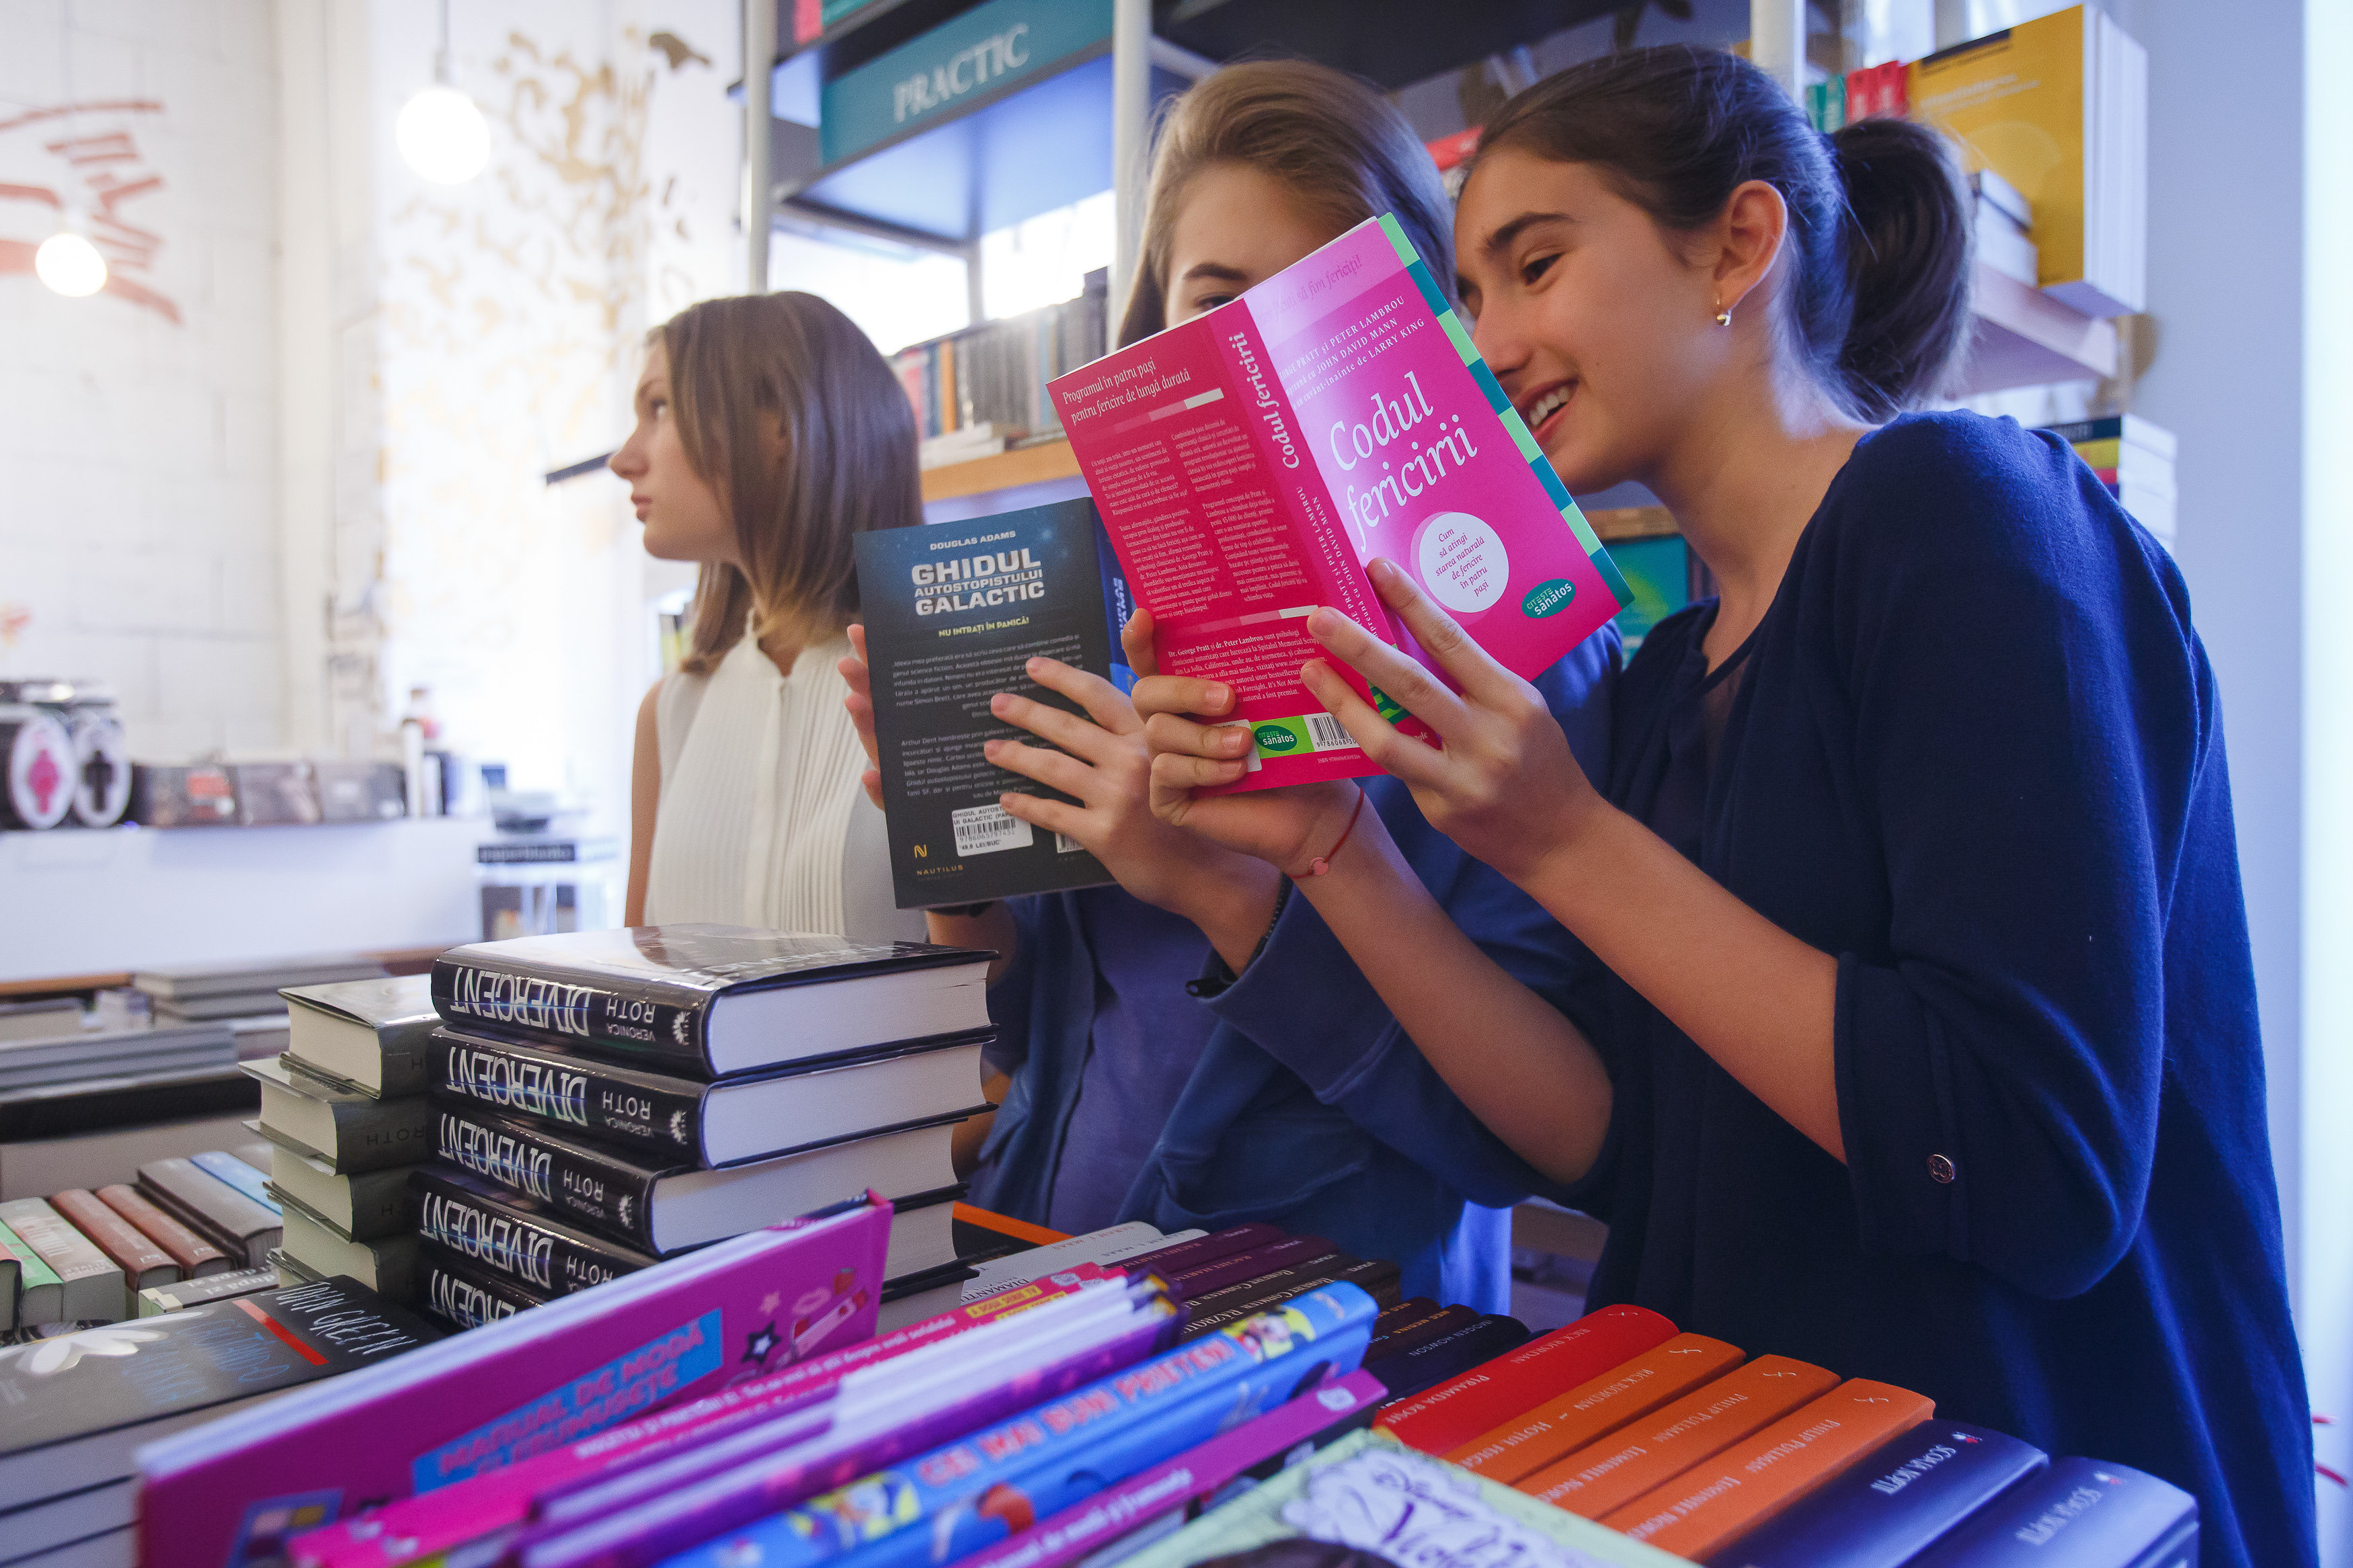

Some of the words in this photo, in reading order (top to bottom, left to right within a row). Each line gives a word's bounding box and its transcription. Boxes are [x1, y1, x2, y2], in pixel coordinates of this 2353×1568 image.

[894, 24, 1029, 123] PRACTIC
[1279, 363, 1296, 382] EORGE
[1296, 346, 1320, 369] PRATT
[1330, 325, 1359, 347] PETER
[1359, 296, 1405, 329] LAMBROU
[1308, 370, 1316, 380] cu
[1316, 354, 1339, 374] JOHN
[1340, 336, 1368, 359] DAVID
[1369, 317, 1398, 341] MANN
[1357, 354, 1368, 366] de
[1367, 333, 1400, 359] LARRY
[1399, 319, 1425, 339] KING
[1228, 332, 1280, 409] fericirii
[1062, 377, 1105, 408] Programul
[1101, 374, 1113, 388] în
[1112, 366, 1138, 388] patru
[1070, 404, 1098, 425] pentru
[1094, 391, 1126, 417] fericire
[1123, 386, 1136, 403] de
[1134, 377, 1162, 402] lungă
[1159, 366, 1191, 390] durată
[1330, 370, 1434, 470] Codul
[1263, 411, 1300, 469] Codul
[1347, 414, 1478, 553] fericirii
[1296, 485, 1321, 534] LAMBROU
[1312, 495, 1329, 526] MANN
[929, 536, 978, 551] DOUGLAS
[980, 530, 1016, 542] ADAMS
[1325, 527, 1343, 558] DAVID
[1438, 528, 1455, 542] Cum
[1439, 548, 1448, 558] să
[1448, 533, 1468, 552] atingi
[1181, 551, 1198, 561] George
[1197, 548, 1209, 556] Pratt
[1318, 535, 1334, 567] PETER
[1435, 559, 1457, 577] starea
[1455, 536, 1485, 561] naturală
[910, 545, 1041, 587] GHIDUL
[1146, 570, 1158, 578] Peter
[1177, 563, 1188, 571] Asta
[1339, 559, 1355, 586] JOHN
[1451, 571, 1460, 581] de
[1460, 553, 1484, 577] fericire
[1460, 580, 1470, 590] în
[1468, 567, 1488, 585] patru
[914, 568, 1043, 599] AUTOSTOPISTULUI
[1336, 579, 1354, 610] PRATT
[1353, 587, 1361, 598] cu
[914, 579, 1045, 618] GALACTIC
[939, 628, 951, 638] NU
[986, 620, 995, 630] ÎN
[1170, 656, 1194, 666] clinicieni
[1257, 641, 1278, 652] Spitalul
[1277, 636, 1303, 649] Memorial
[1176, 646, 1197, 657] George
[1195, 643, 1210, 652] Pratt
[1223, 638, 1239, 647] Peter
[1238, 633, 1263, 645] Lambrou
[1275, 628, 1300, 641] psihologi
[1203, 659, 1231, 670] California,
[1230, 657, 1244, 665] unde
[1293, 645, 1316, 657] cabinete
[1235, 675, 1254, 684] autorul
[1285, 677, 1302, 686] About
[1241, 693, 1261, 702] autorul
[1276, 688, 1300, 698] premiat.
[953, 810, 975, 819] GHIDUL
[978, 805, 1002, 815] AUTOST
[962, 814, 992, 824] GALACTIC
[916, 863, 963, 878] NAUTILUS
[450, 967, 593, 1036] DIVERGENT
[606, 998, 655, 1023] ROTH
[607, 1023, 655, 1041] VERONICA
[446, 1046, 588, 1126] DIVERGENT
[602, 1091, 651, 1120] ROTH
[366, 1124, 427, 1147] ROTH
[605, 1116, 654, 1138] VERONICA
[438, 1114, 553, 1202] DIVERGENT
[563, 1169, 604, 1202] ROTH
[420, 1192, 555, 1289] DIVERGENT
[1174, 1264, 1223, 1282] HARTM
[1223, 1255, 1253, 1270] RACHEL
[960, 1278, 1029, 1303] DIAMANTU
[1252, 1270, 1295, 1288] ROBERT
[1291, 1278, 1335, 1296] ROBERT
[260, 1282, 345, 1313] JOHN
[1199, 1284, 1253, 1308] CORMIER
[1240, 1292, 1293, 1316] CORMIER
[1392, 1319, 1429, 1333] MEDINA
[1429, 1310, 1450, 1320] MEG
[1454, 1319, 1493, 1337] IMOGEN
[310, 1310, 417, 1355] GREEN
[1409, 1334, 1454, 1357] HOWSON
[1565, 1328, 1591, 1342] RICK
[1510, 1339, 1564, 1364] RIORDAN
[1423, 1374, 1490, 1404] PIRAMIDA
[1622, 1369, 1654, 1389] RICK
[1574, 1382, 1629, 1410] RIORDAN
[1710, 1393, 1748, 1415] PHILIP
[1652, 1413, 1712, 1443] PULLMAN
[1798, 1419, 1841, 1442] PHILIP
[1745, 1438, 1806, 1473] PULLMAN
